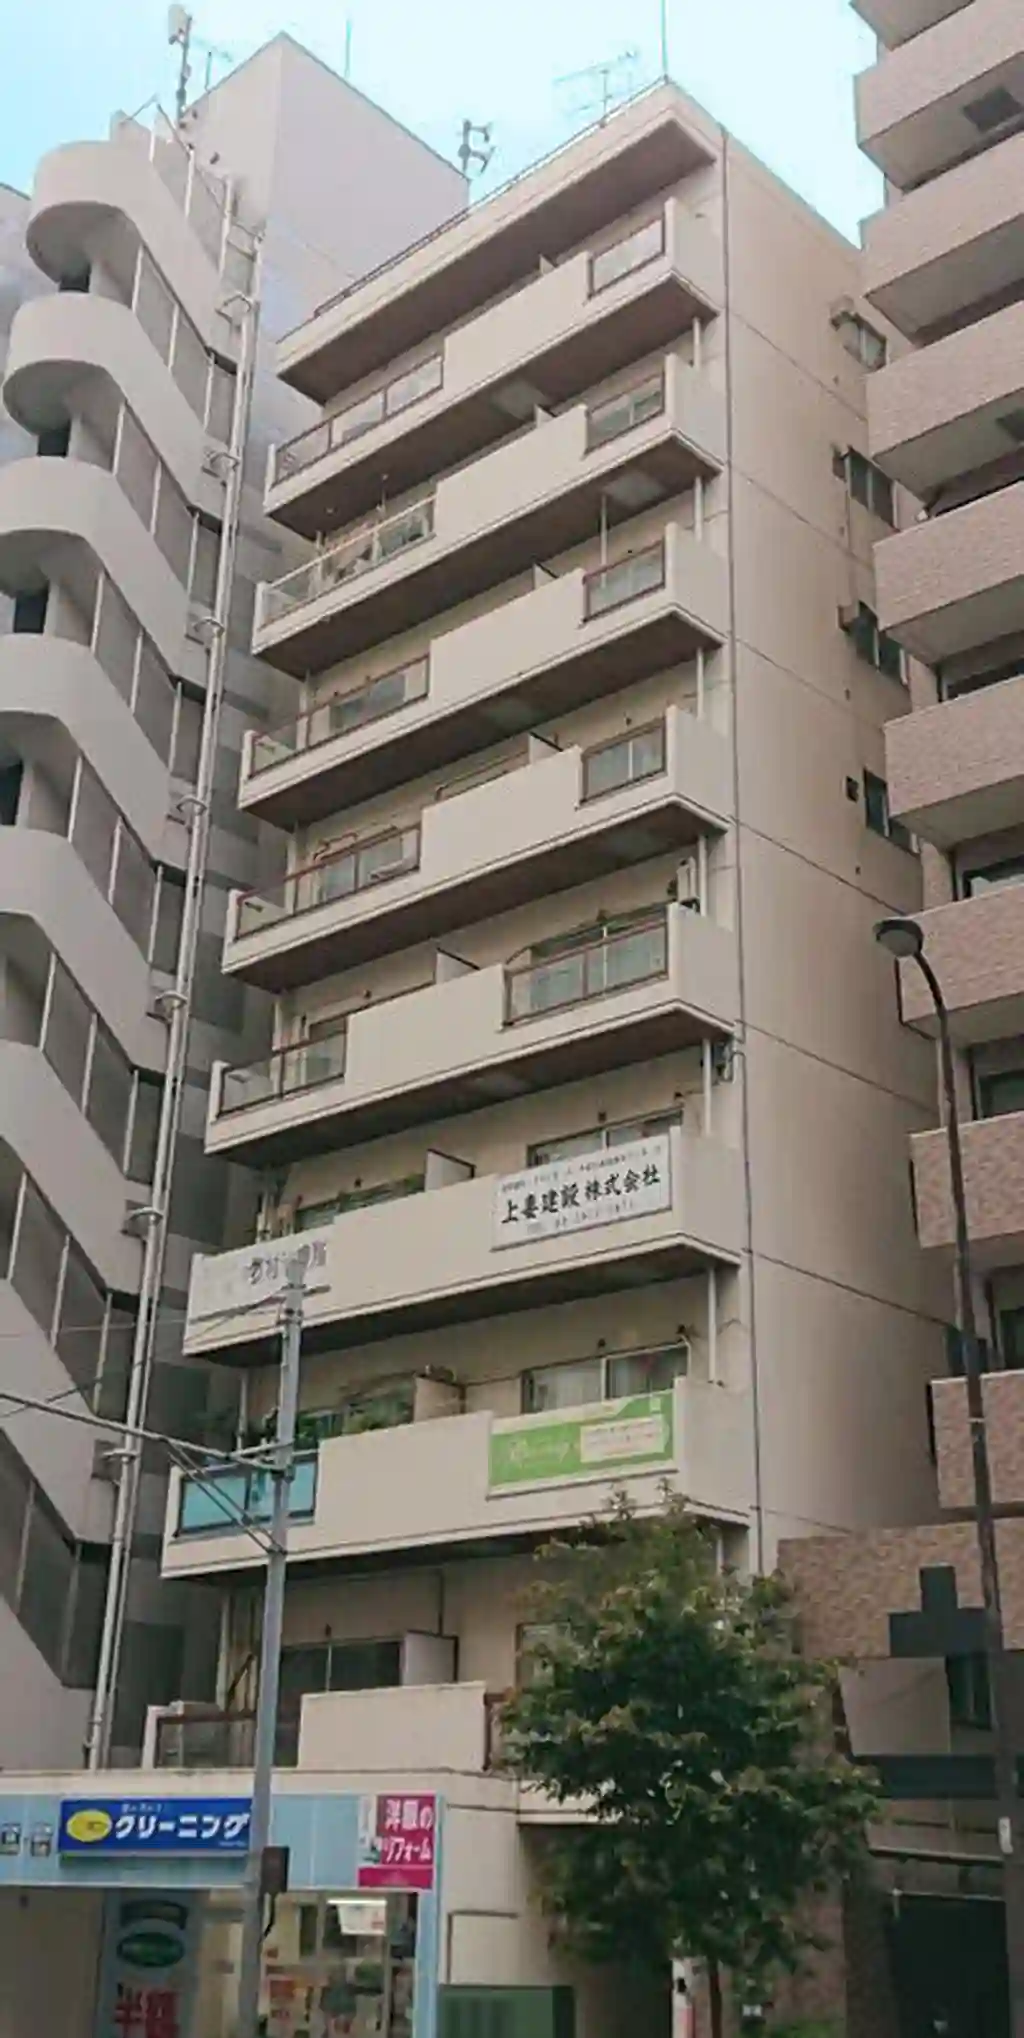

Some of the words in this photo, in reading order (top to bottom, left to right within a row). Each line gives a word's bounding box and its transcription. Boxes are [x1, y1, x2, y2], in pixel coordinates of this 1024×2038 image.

[115, 1812, 251, 1840] クリーニング
